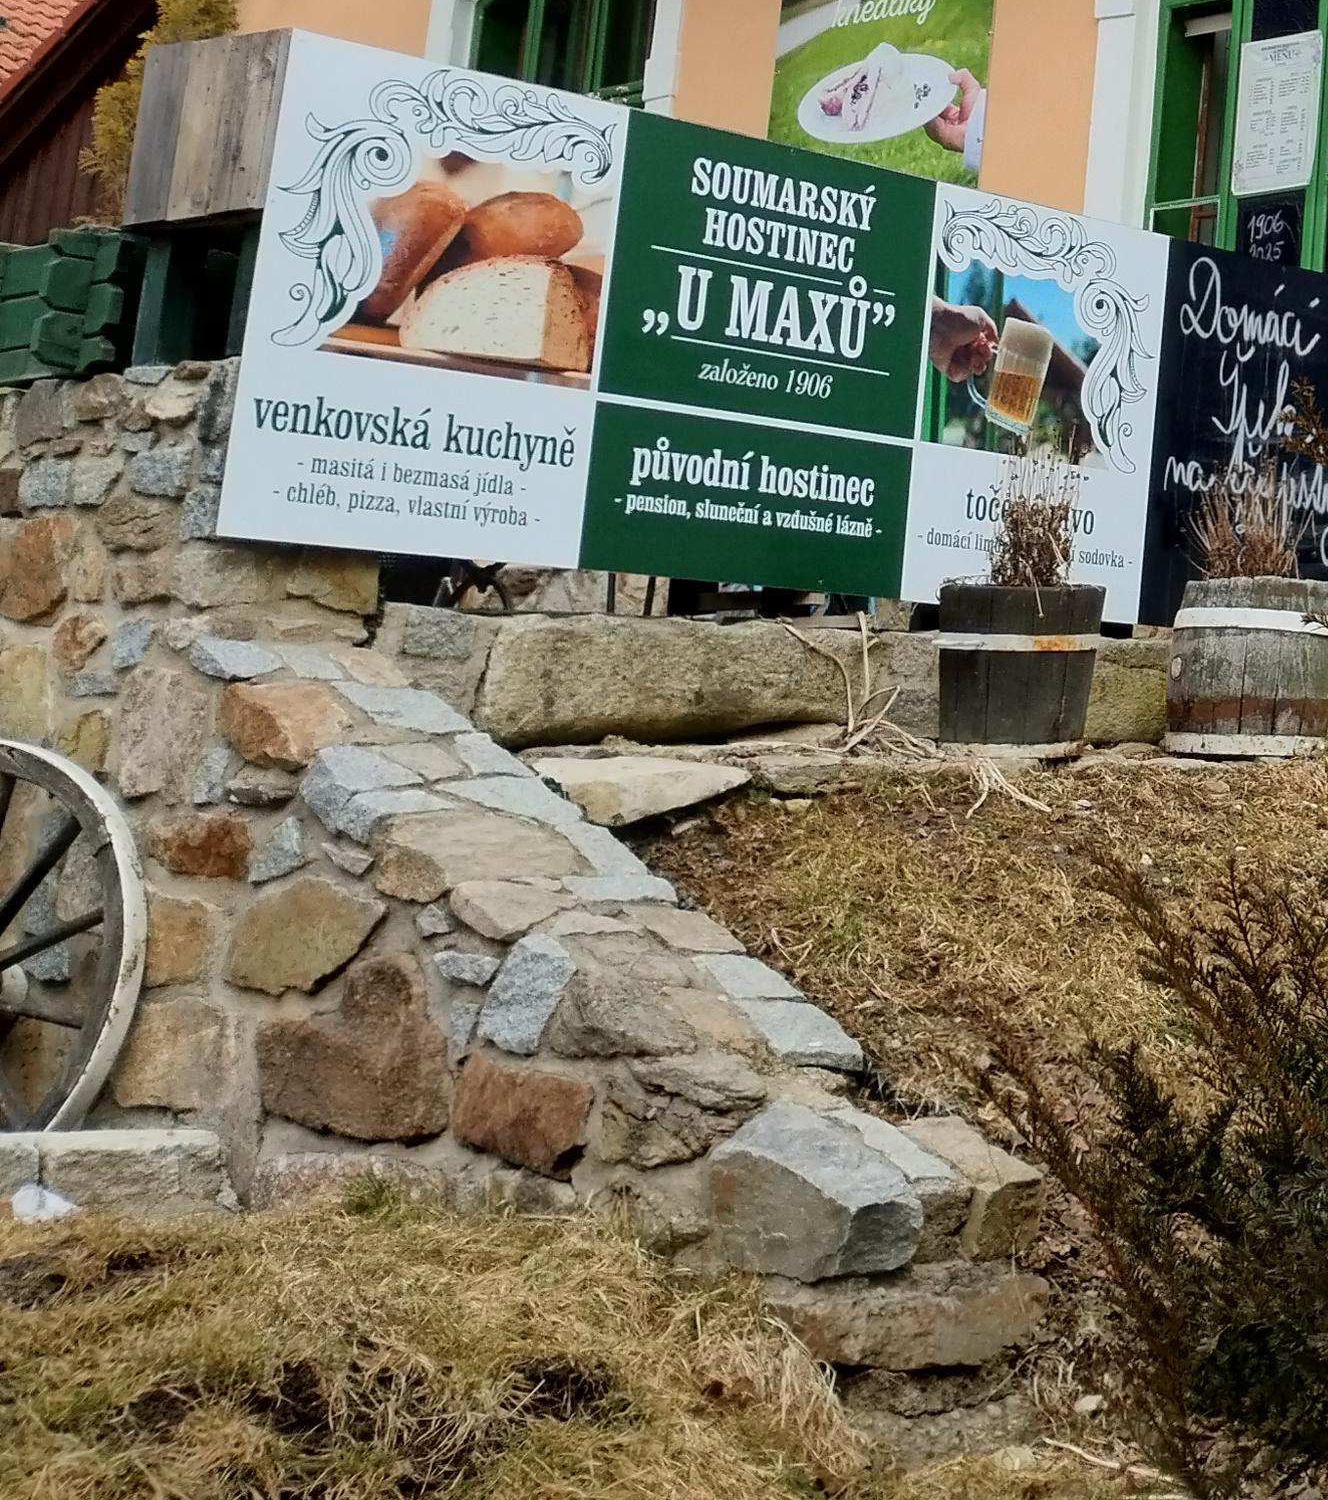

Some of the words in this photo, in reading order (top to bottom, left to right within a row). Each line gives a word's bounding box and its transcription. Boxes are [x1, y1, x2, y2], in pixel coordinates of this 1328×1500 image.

[691, 157, 877, 231] SOUMARSKÝ
[702, 207, 855, 273] HOSTINEC
[1247, 210, 1285, 243] 1906
[1180, 256, 1321, 356] Domácí
[698, 358, 779, 390] založeno
[785, 369, 834, 399] 1906
[253, 396, 432, 451] venkovská
[443, 413, 576, 472] kuchyně
[311, 456, 374, 481] masitá
[380, 462, 387, 481] i
[393, 462, 470, 491] bezmasá
[473, 471, 514, 496] jídla
[630, 437, 755, 491] původní
[758, 455, 875, 507] hostinec
[1164, 456, 1216, 491] na
[286, 482, 340, 508] chléb,
[347, 490, 401, 515] pizza,
[408, 495, 468, 521] vlastní
[473, 501, 527, 528] výroba
[625, 493, 691, 519] pension,
[695, 498, 760, 525] sluneční
[763, 510, 772, 526] a
[776, 510, 833, 533] vzdušné
[836, 515, 873, 538] lázně
[927, 527, 973, 549] domácí
[1078, 548, 1124, 568] sodovka
